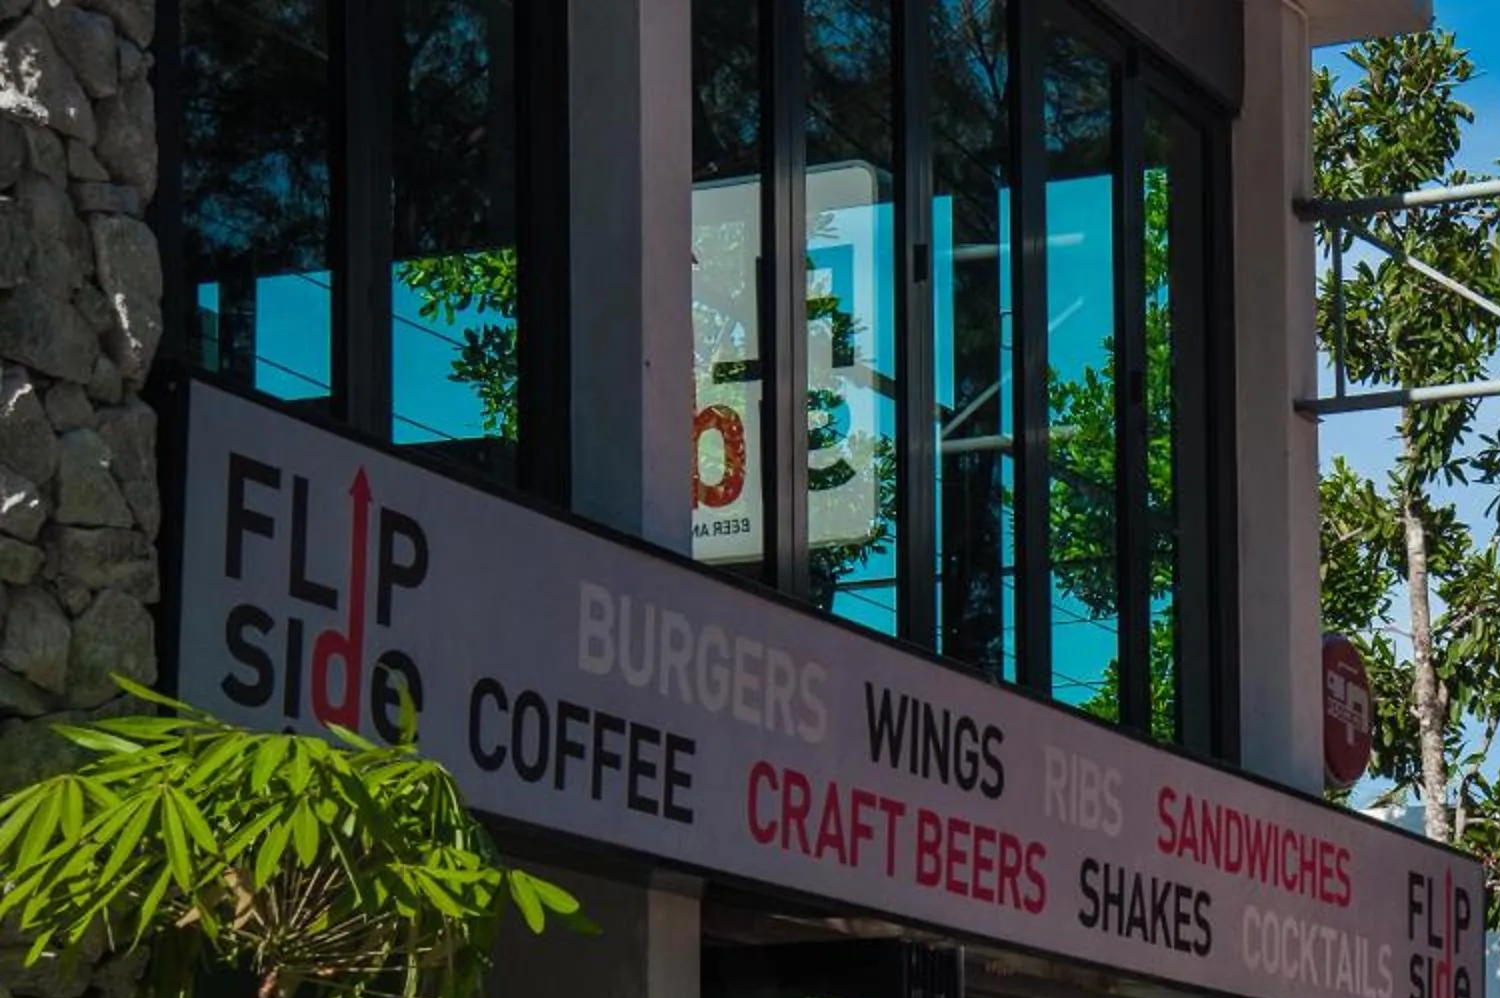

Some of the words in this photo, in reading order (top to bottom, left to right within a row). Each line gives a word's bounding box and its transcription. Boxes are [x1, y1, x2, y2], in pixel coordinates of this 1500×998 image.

[578, 581, 829, 744] BURGERS
[469, 678, 696, 824] COFFEE
[865, 681, 1005, 799] WINGS
[1043, 743, 1123, 838] RIBS
[747, 761, 906, 877] CRAFT
[916, 808, 1047, 914] BEERS
[1157, 786, 1352, 908] SANDWICHES
[1078, 857, 1212, 957] SHAKES
